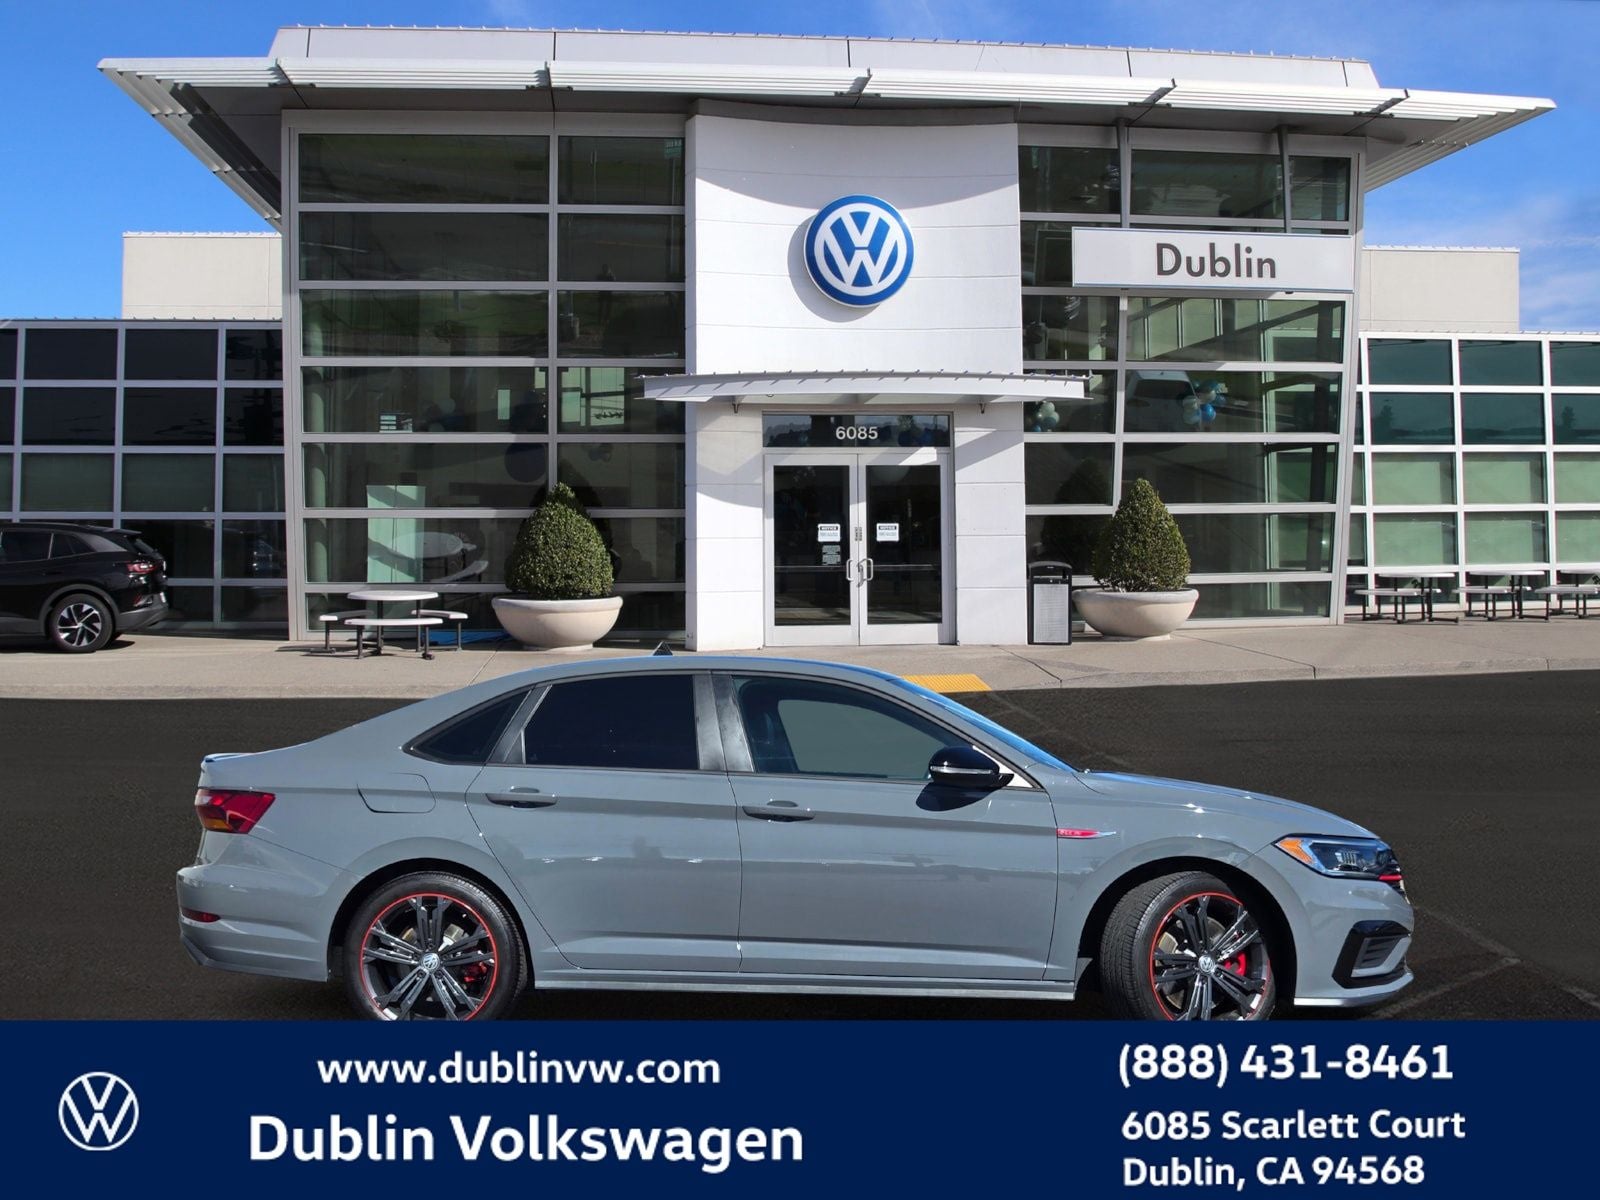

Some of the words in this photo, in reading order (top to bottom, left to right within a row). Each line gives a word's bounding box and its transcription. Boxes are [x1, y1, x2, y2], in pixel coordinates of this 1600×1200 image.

[811, 200, 910, 299] VW
[1157, 242, 1277, 279] Dublin
[835, 426, 878, 440] 6085
